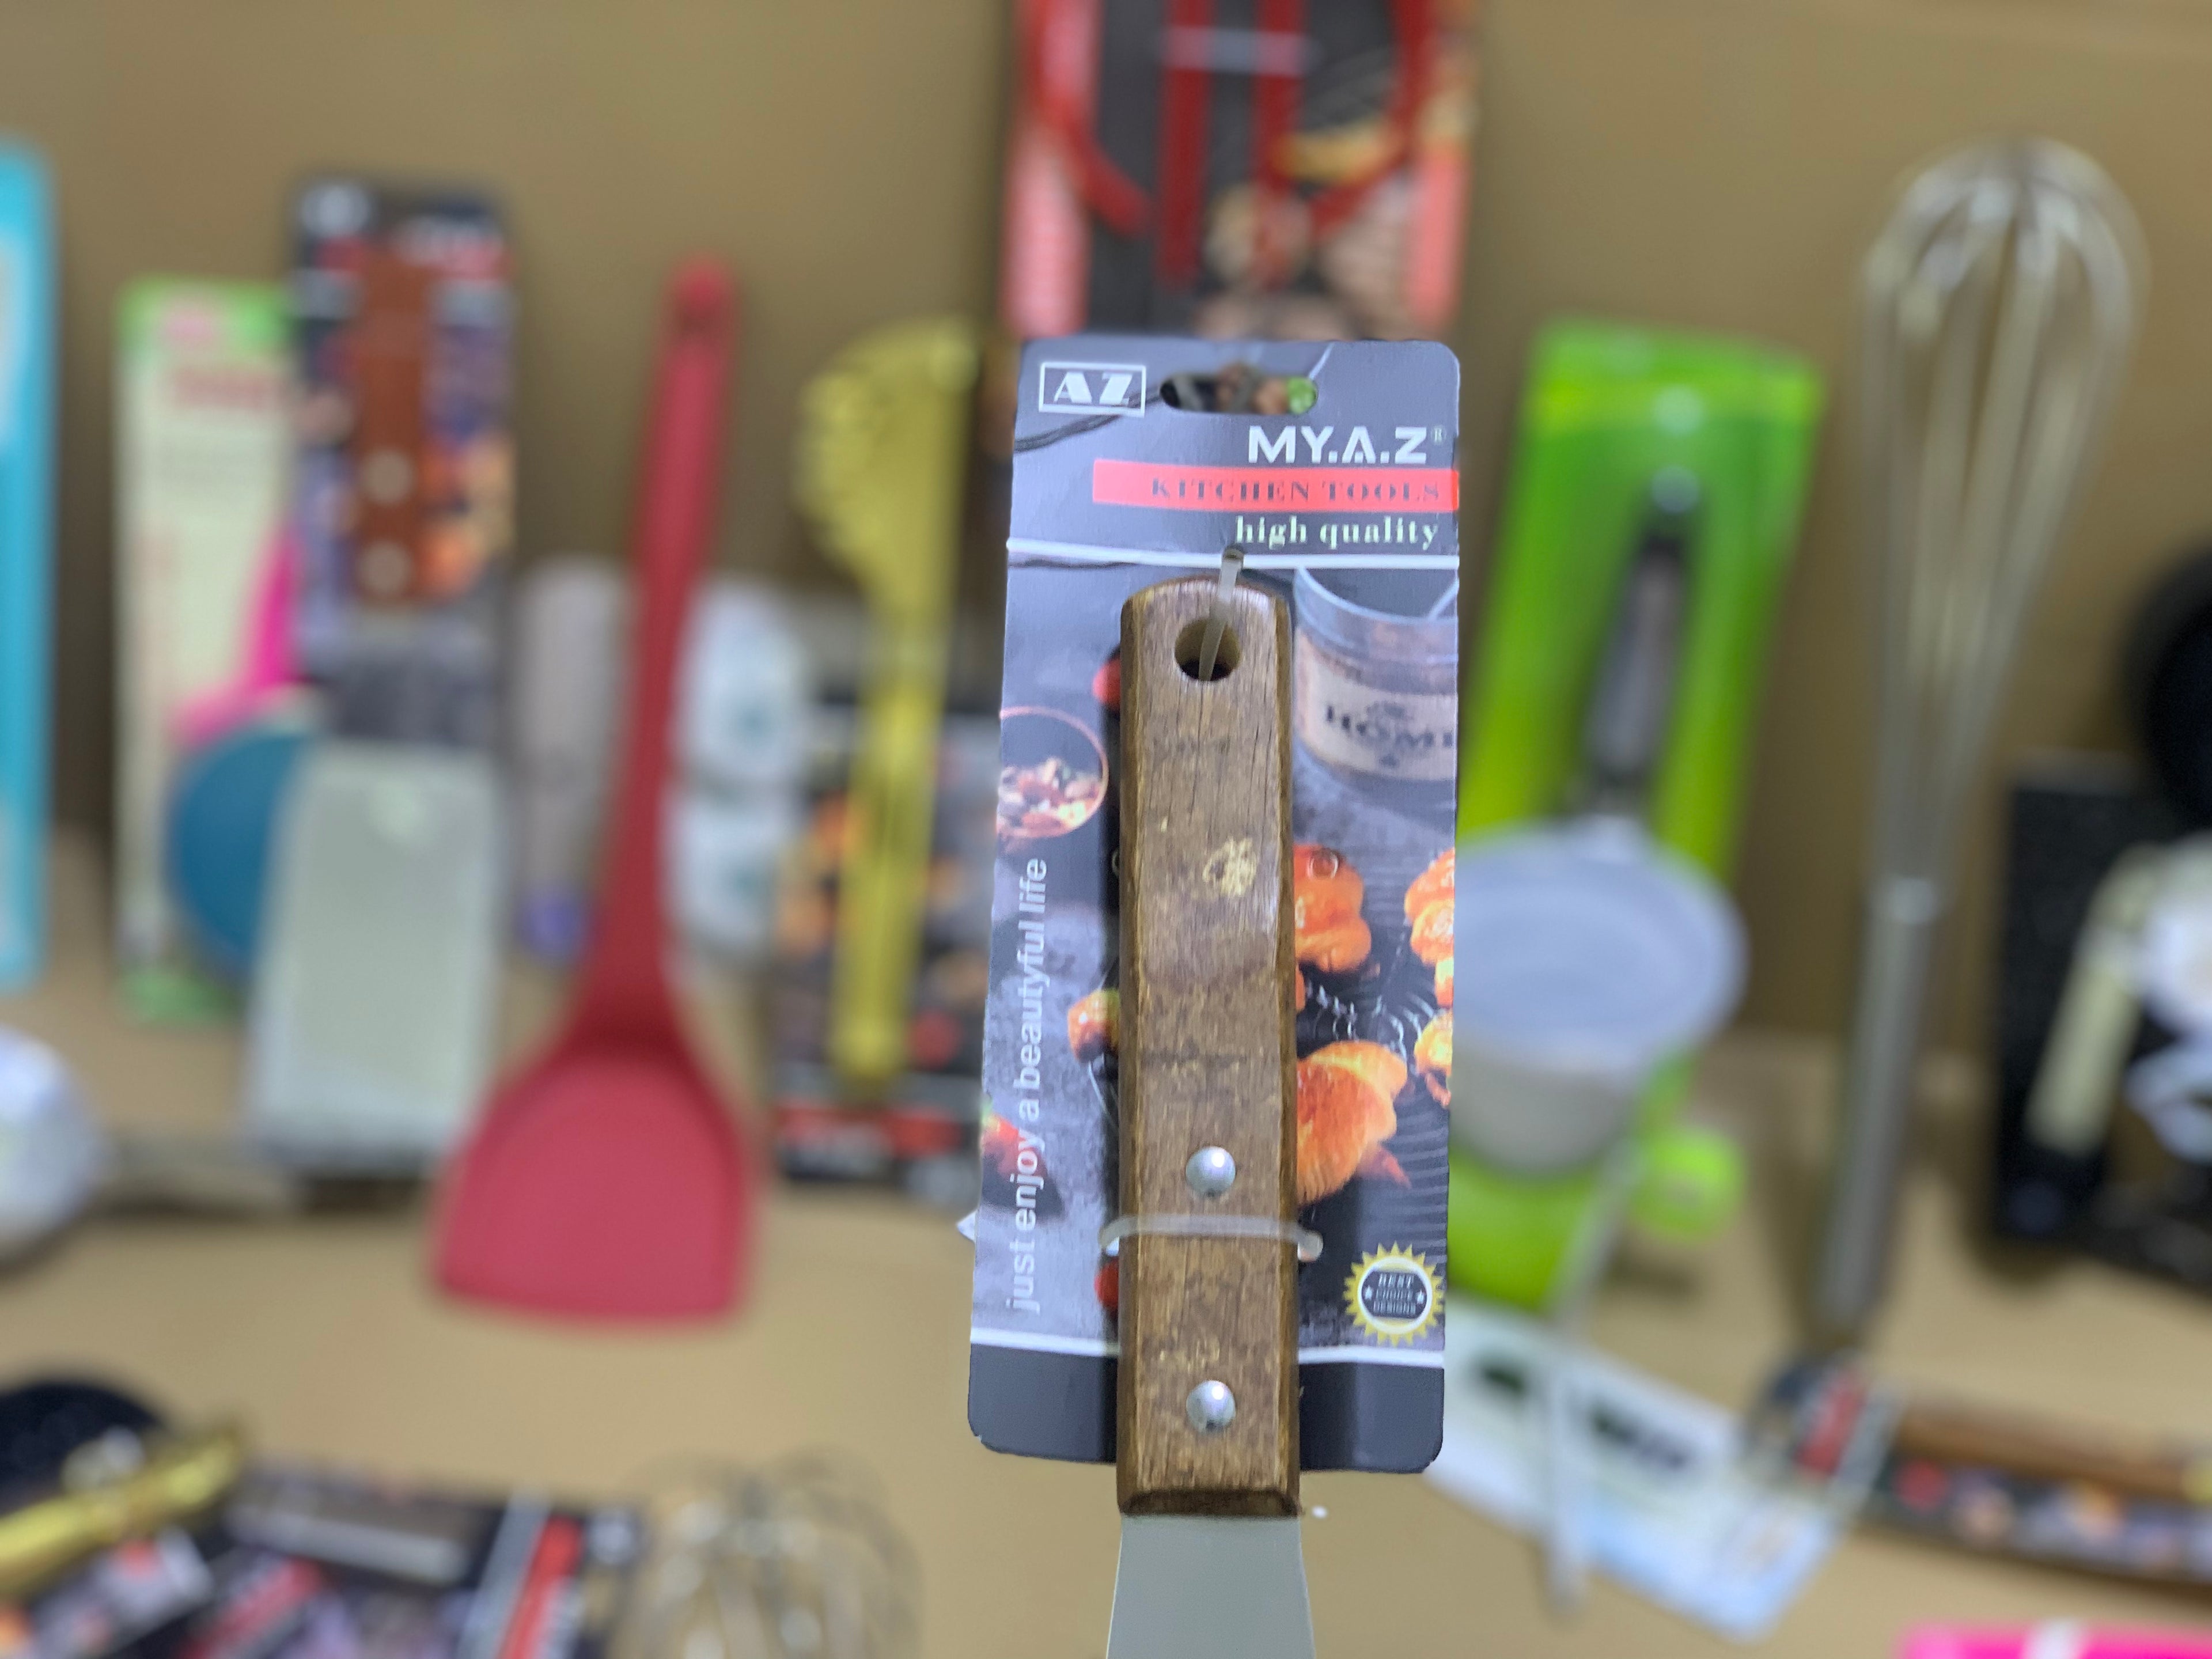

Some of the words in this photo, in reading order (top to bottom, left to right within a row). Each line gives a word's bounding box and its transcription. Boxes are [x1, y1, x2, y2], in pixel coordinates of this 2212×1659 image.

[1053, 371, 1134, 406] AZ
[1152, 477, 1309, 502] KITCHEN
[1321, 481, 1439, 502] TOOLS
[1234, 515, 1306, 550] high
[1319, 516, 1438, 551] quality
[1019, 858, 1047, 913] life
[1013, 920, 1050, 1089] beautyful
[1018, 1099, 1040, 1122] a
[1009, 1127, 1046, 1232] enjoy
[1006, 1238, 1041, 1315] just
